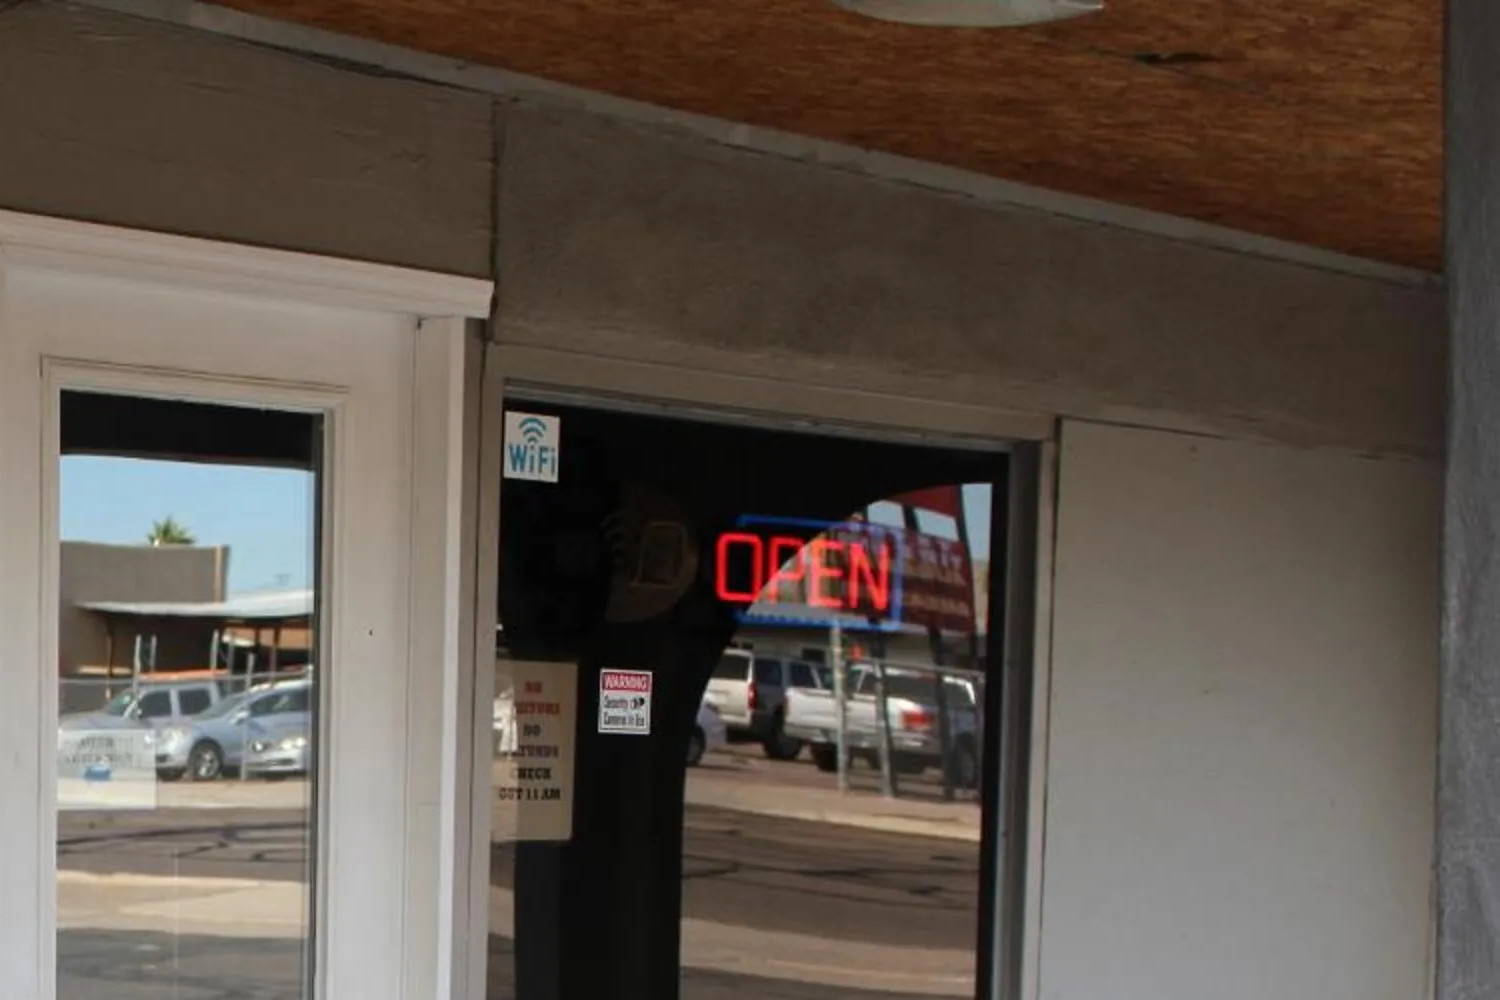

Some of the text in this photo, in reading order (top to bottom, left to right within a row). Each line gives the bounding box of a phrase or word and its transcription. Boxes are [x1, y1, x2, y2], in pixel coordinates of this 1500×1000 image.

[508, 444, 556, 476] WiFi
[715, 532, 890, 610] OPEN
[603, 673, 648, 690] WARNING
[510, 767, 551, 780] CHECK
[541, 788, 561, 800] AM
